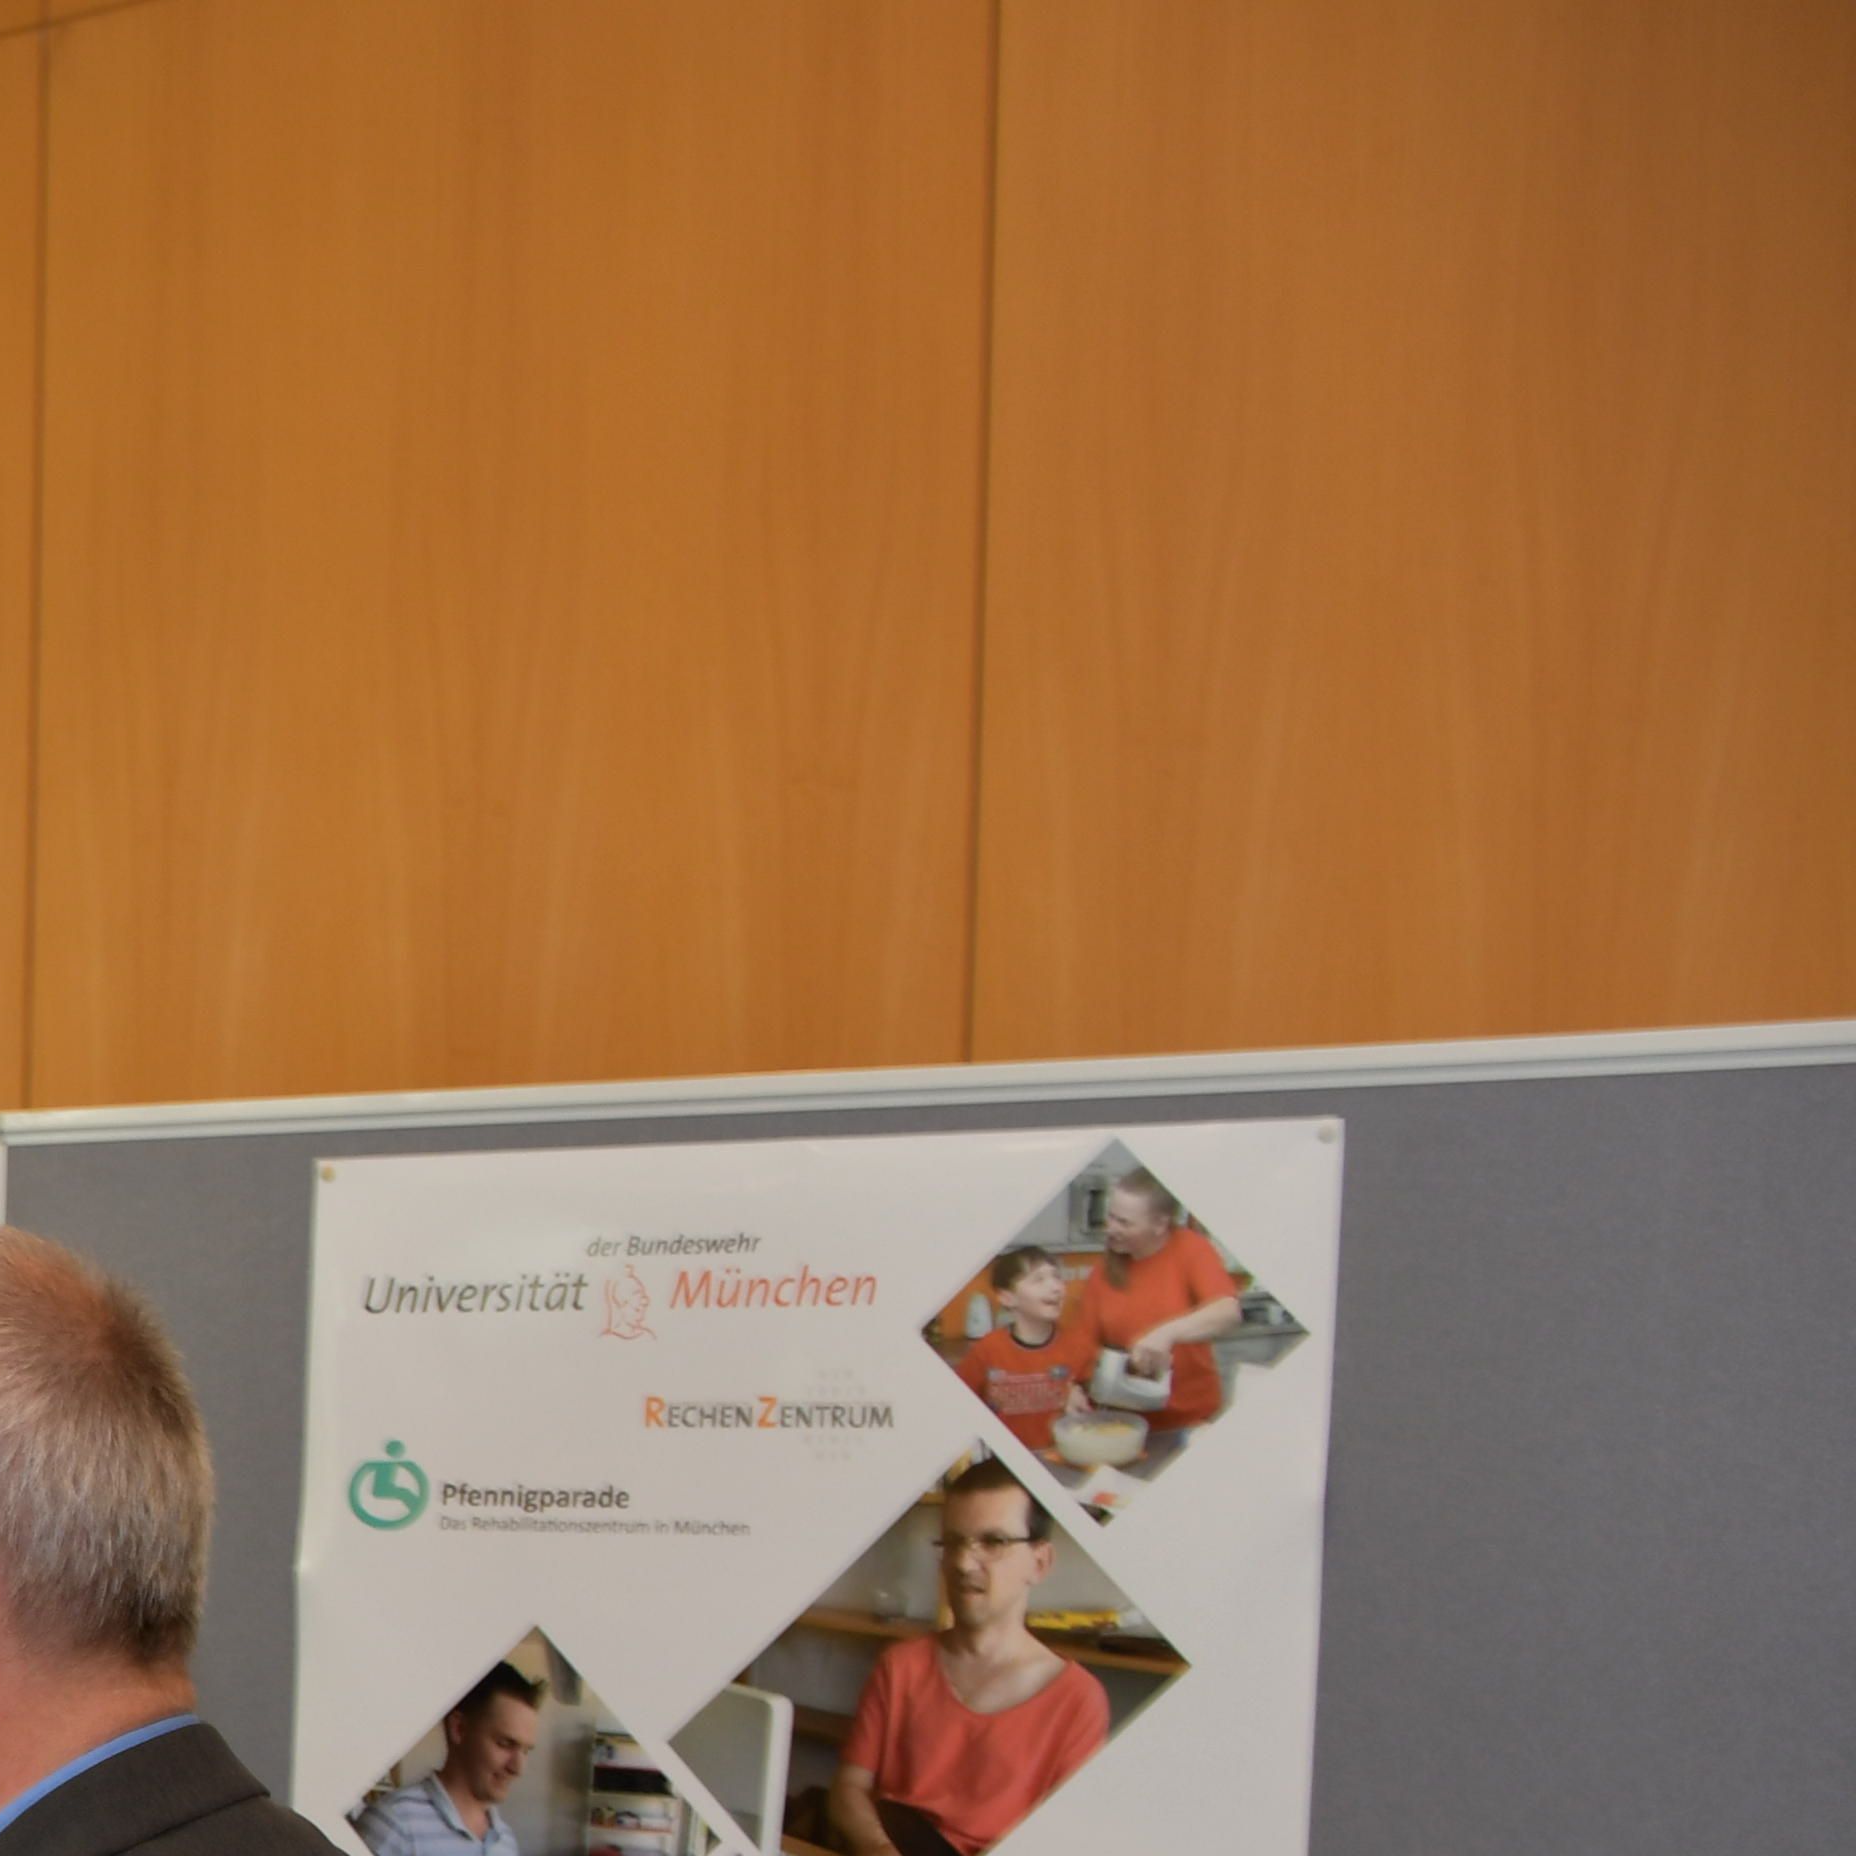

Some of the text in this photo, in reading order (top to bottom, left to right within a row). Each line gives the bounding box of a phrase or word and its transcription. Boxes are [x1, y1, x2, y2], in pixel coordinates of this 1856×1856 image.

[586, 1232, 761, 1257] der Bundeswehr
[363, 1264, 878, 1314] Universität München
[442, 1481, 630, 1512] Pfennigparade
[440, 1515, 751, 1538] Das Rehabilitationszentrum in München
